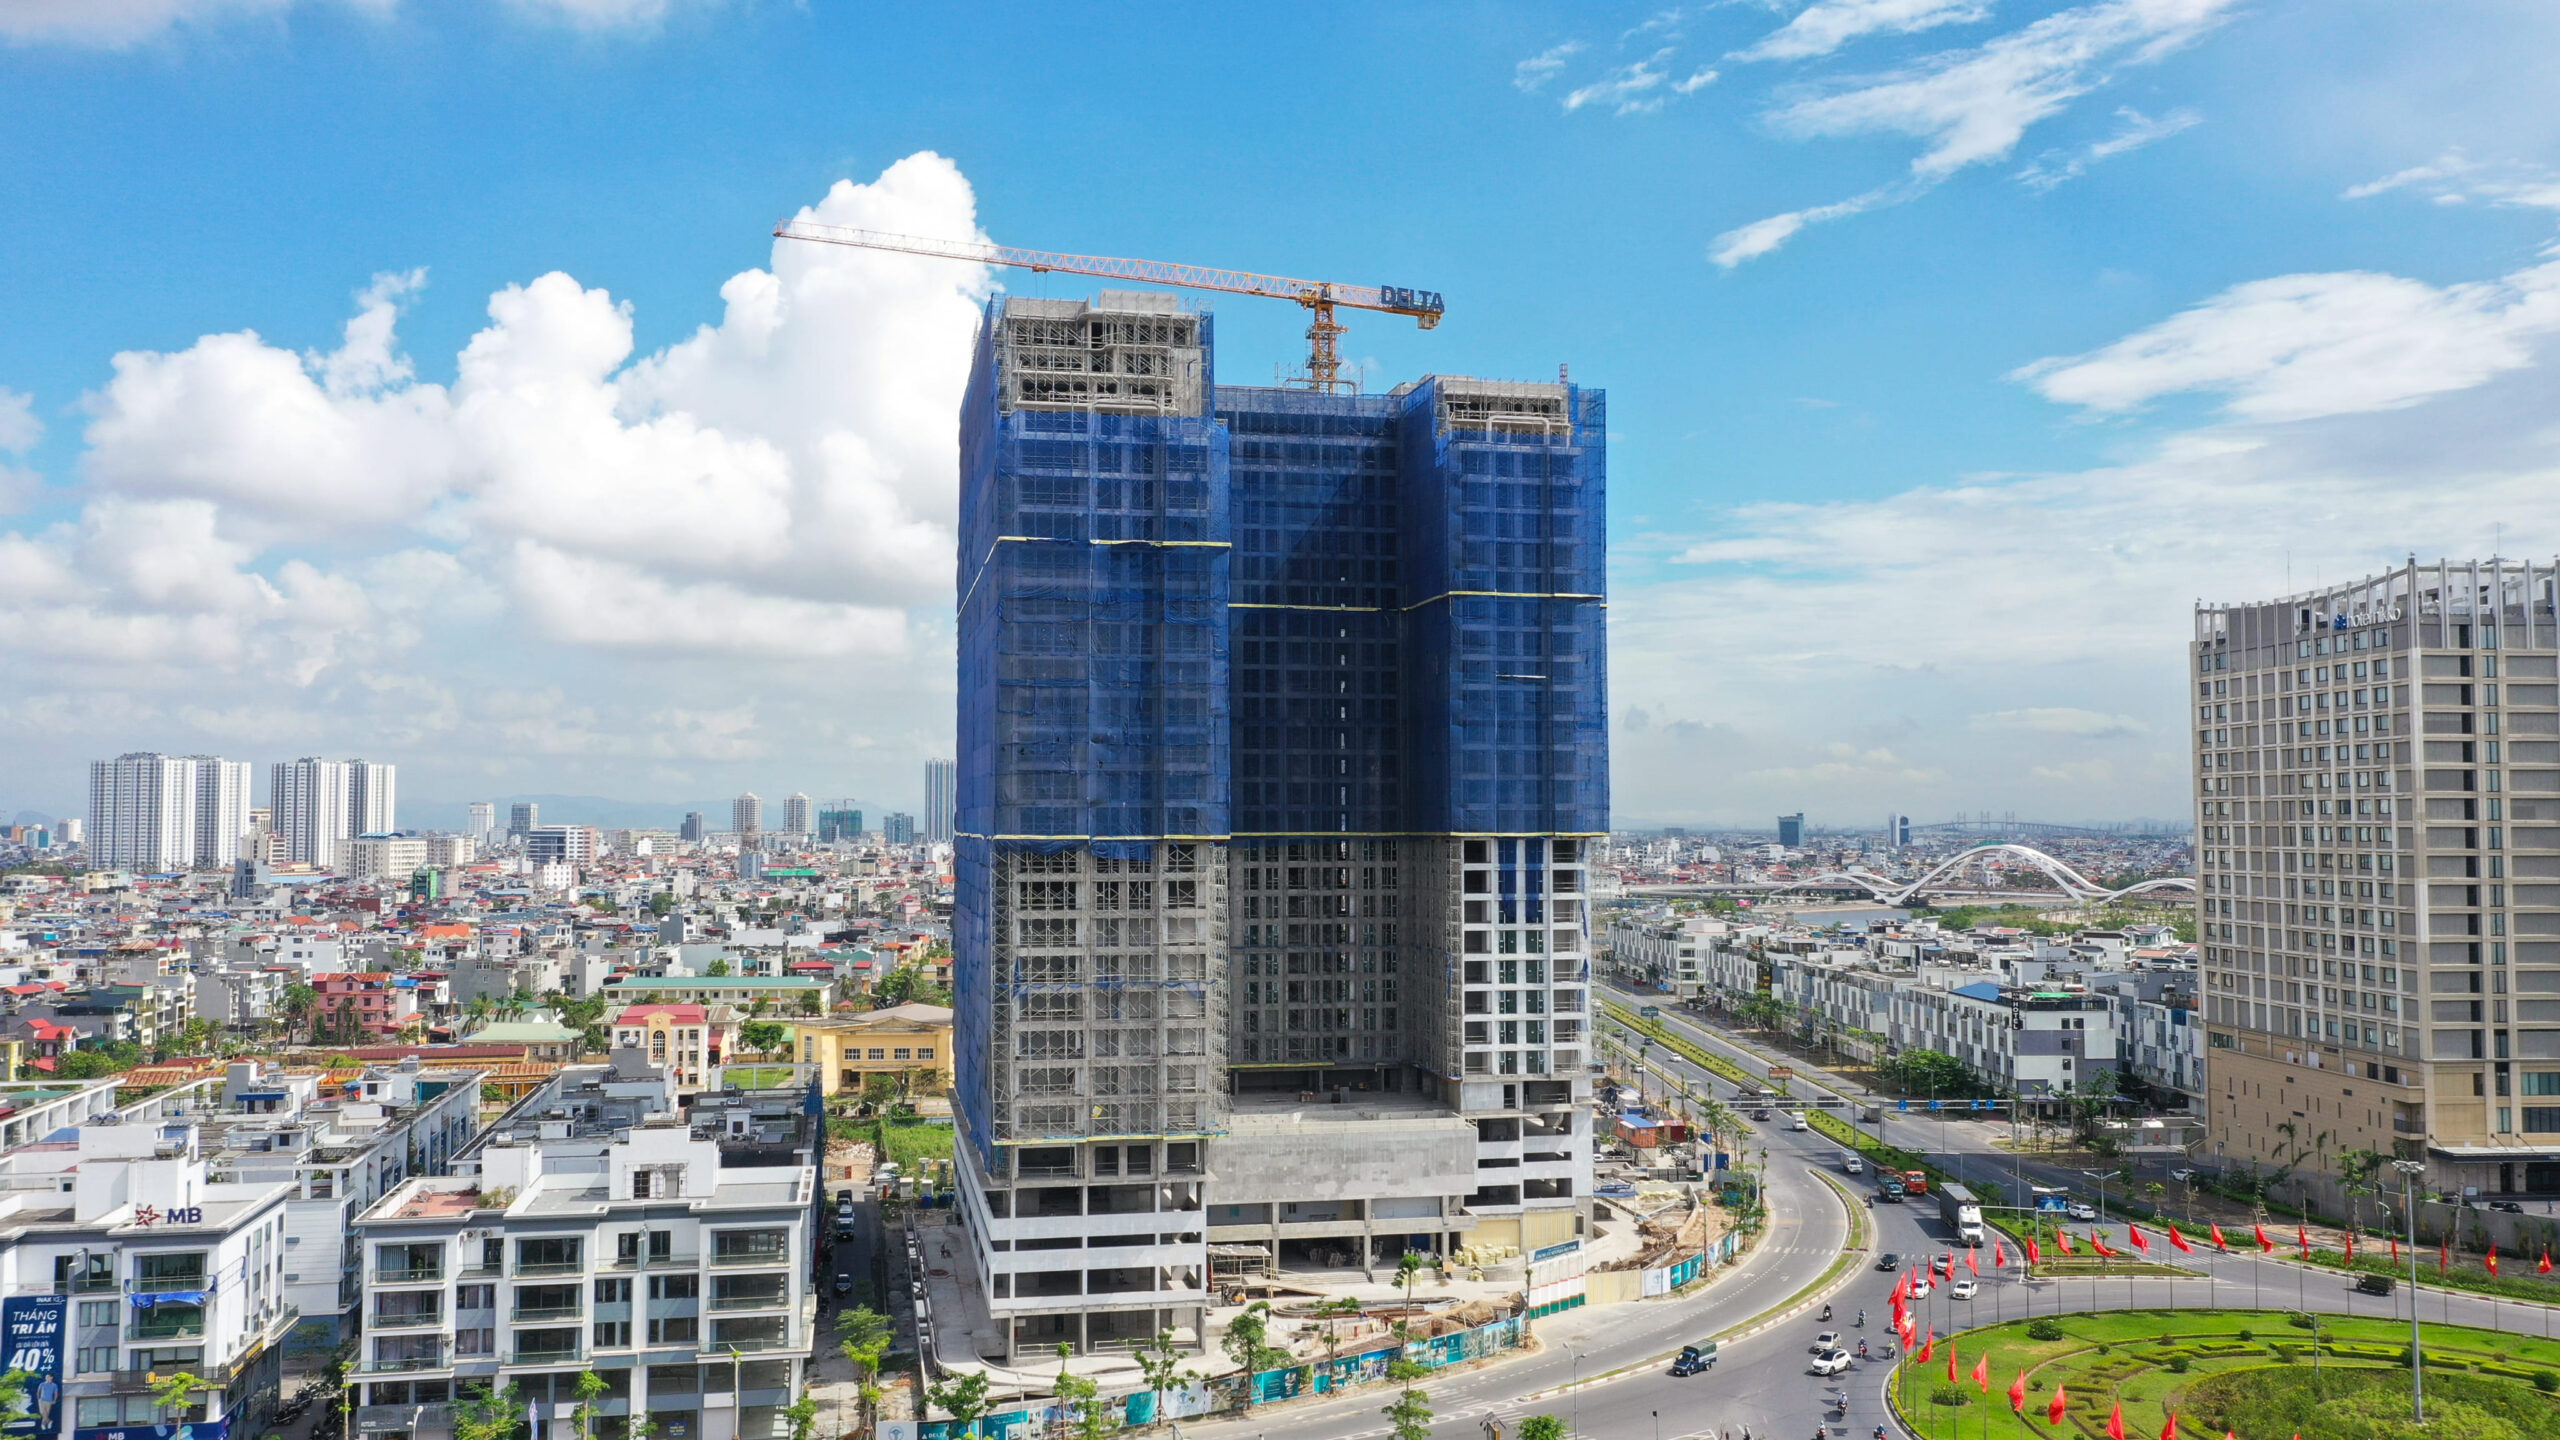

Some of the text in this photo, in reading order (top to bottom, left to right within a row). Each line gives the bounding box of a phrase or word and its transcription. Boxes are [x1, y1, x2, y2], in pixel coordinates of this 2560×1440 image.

[1381, 285, 1445, 313] DELTA
[167, 1207, 202, 1224] MB
[12, 1308, 58, 1321] THÁNG
[11, 1323, 34, 1335] TRI
[108, 1432, 124, 1440] MB
